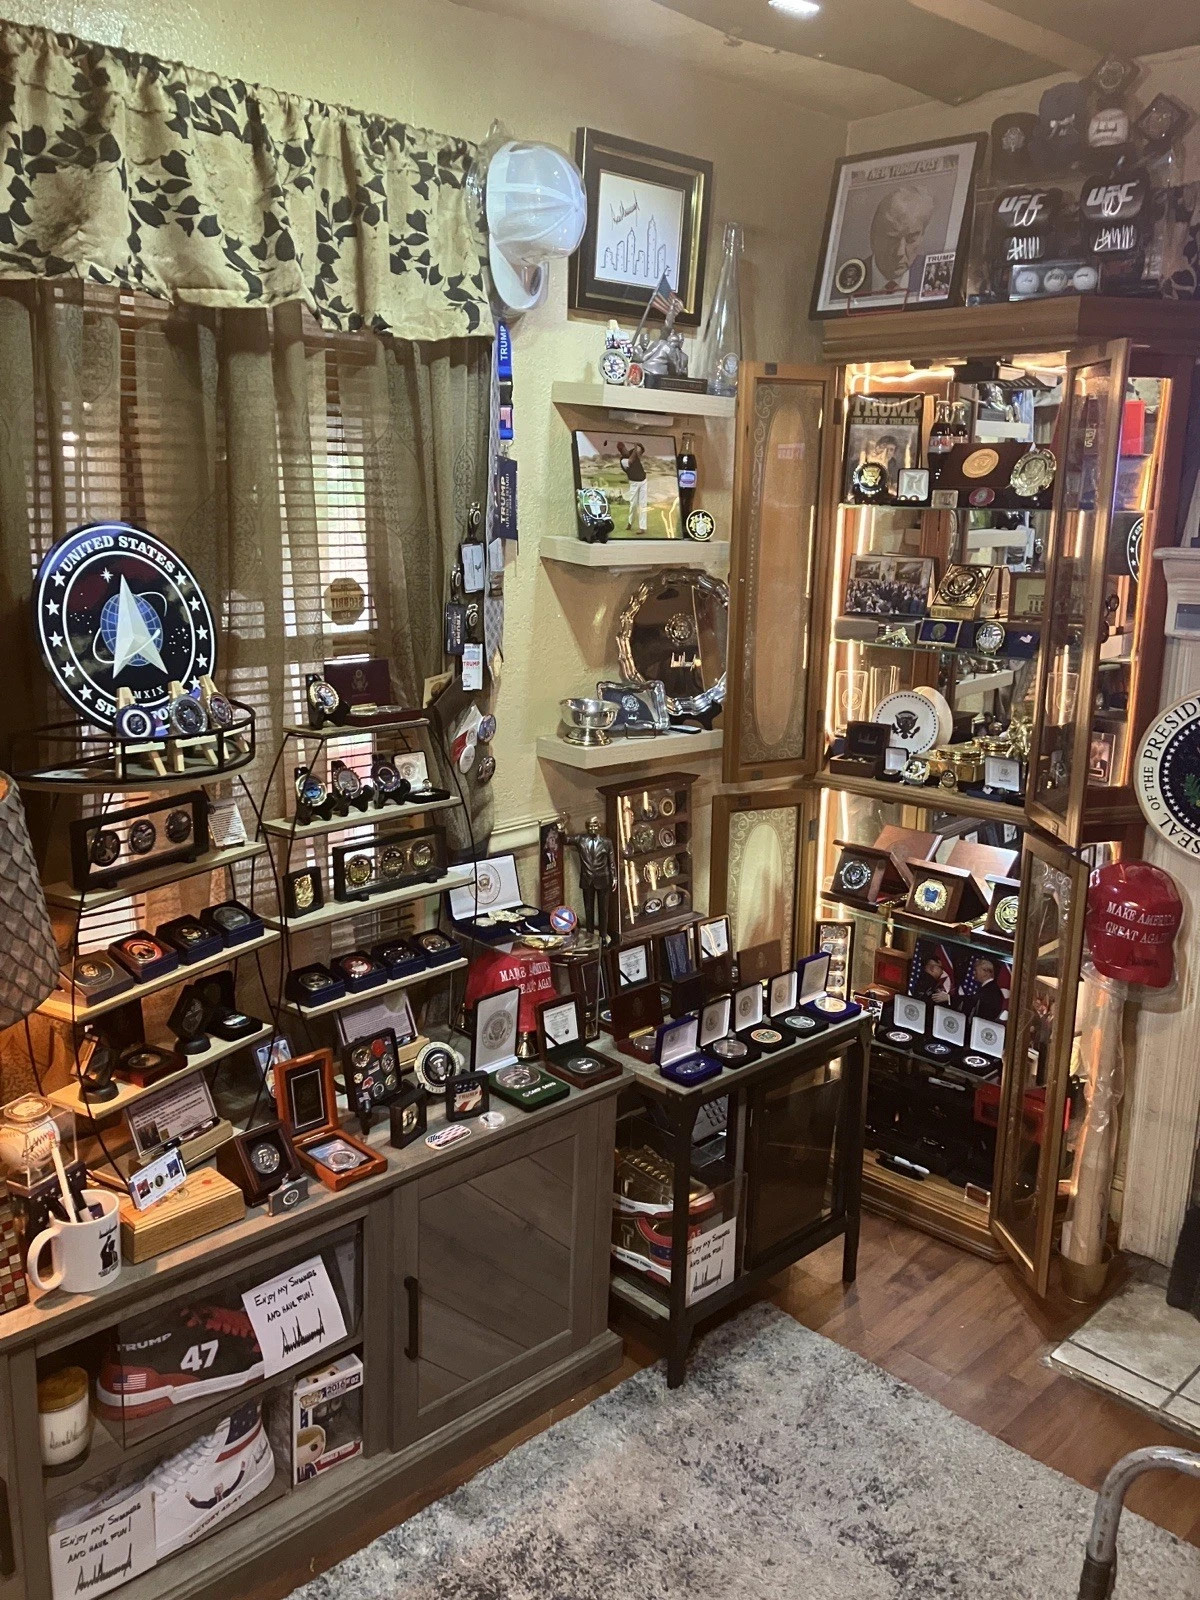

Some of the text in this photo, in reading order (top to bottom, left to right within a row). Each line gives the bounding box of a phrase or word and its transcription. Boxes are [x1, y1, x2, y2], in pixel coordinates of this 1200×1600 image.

[1086, 179, 1140, 206] UFC
[998, 193, 1047, 213] UFC
[928, 253, 955, 262] TRUMP
[500, 325, 508, 361] TRUMP
[851, 397, 922, 417] TRUMP
[60, 535, 176, 573] UNITED STATES
[133, 685, 165, 699] MXIX
[1143, 697, 1200, 855] SEAL OF THE PRESID
[1106, 901, 1137, 921] MAKE
[1105, 921, 1139, 941] GREAT
[459, 1091, 479, 1100] TRUMP
[266, 1281, 314, 1323] AND HAVE FUN!
[117, 1333, 172, 1352] TRUMP
[180, 1339, 219, 1372] 47
[327, 1380, 346, 1394] 2016
[67, 1550, 86, 1564] AND
